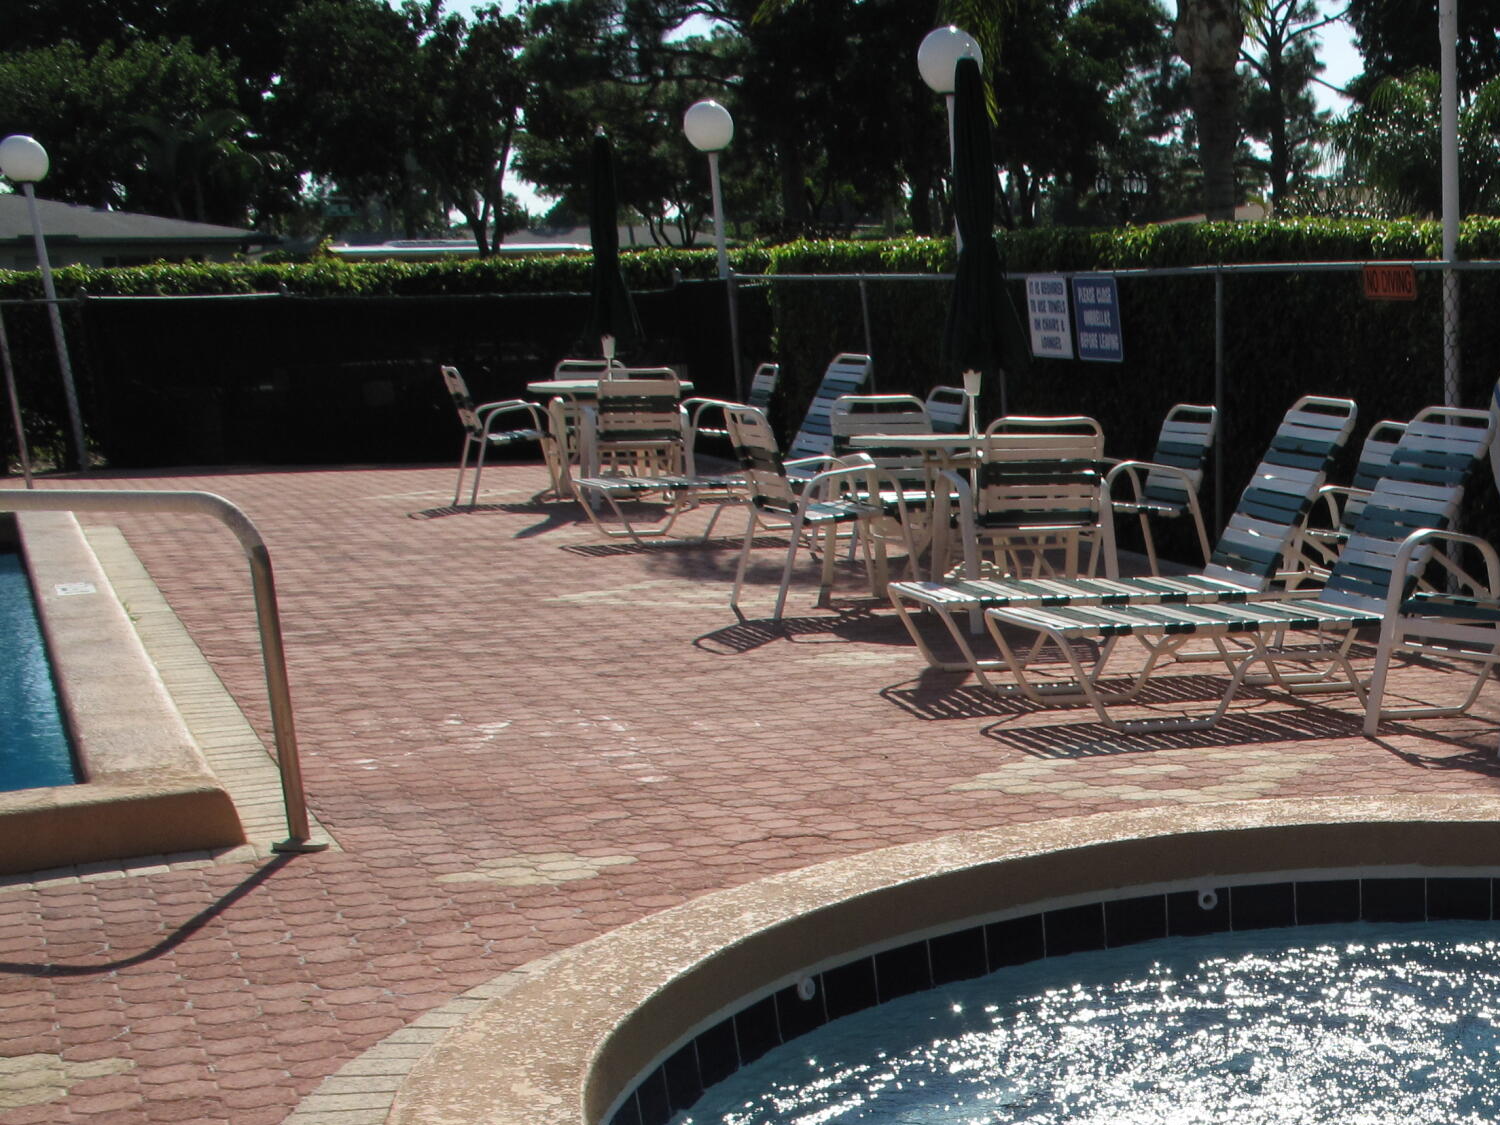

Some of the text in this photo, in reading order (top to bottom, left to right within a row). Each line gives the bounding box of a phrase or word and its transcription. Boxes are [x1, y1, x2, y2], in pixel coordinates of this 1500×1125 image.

[1366, 270, 1413, 293] NO DIVING
[1078, 286, 1096, 304] PLEASE
